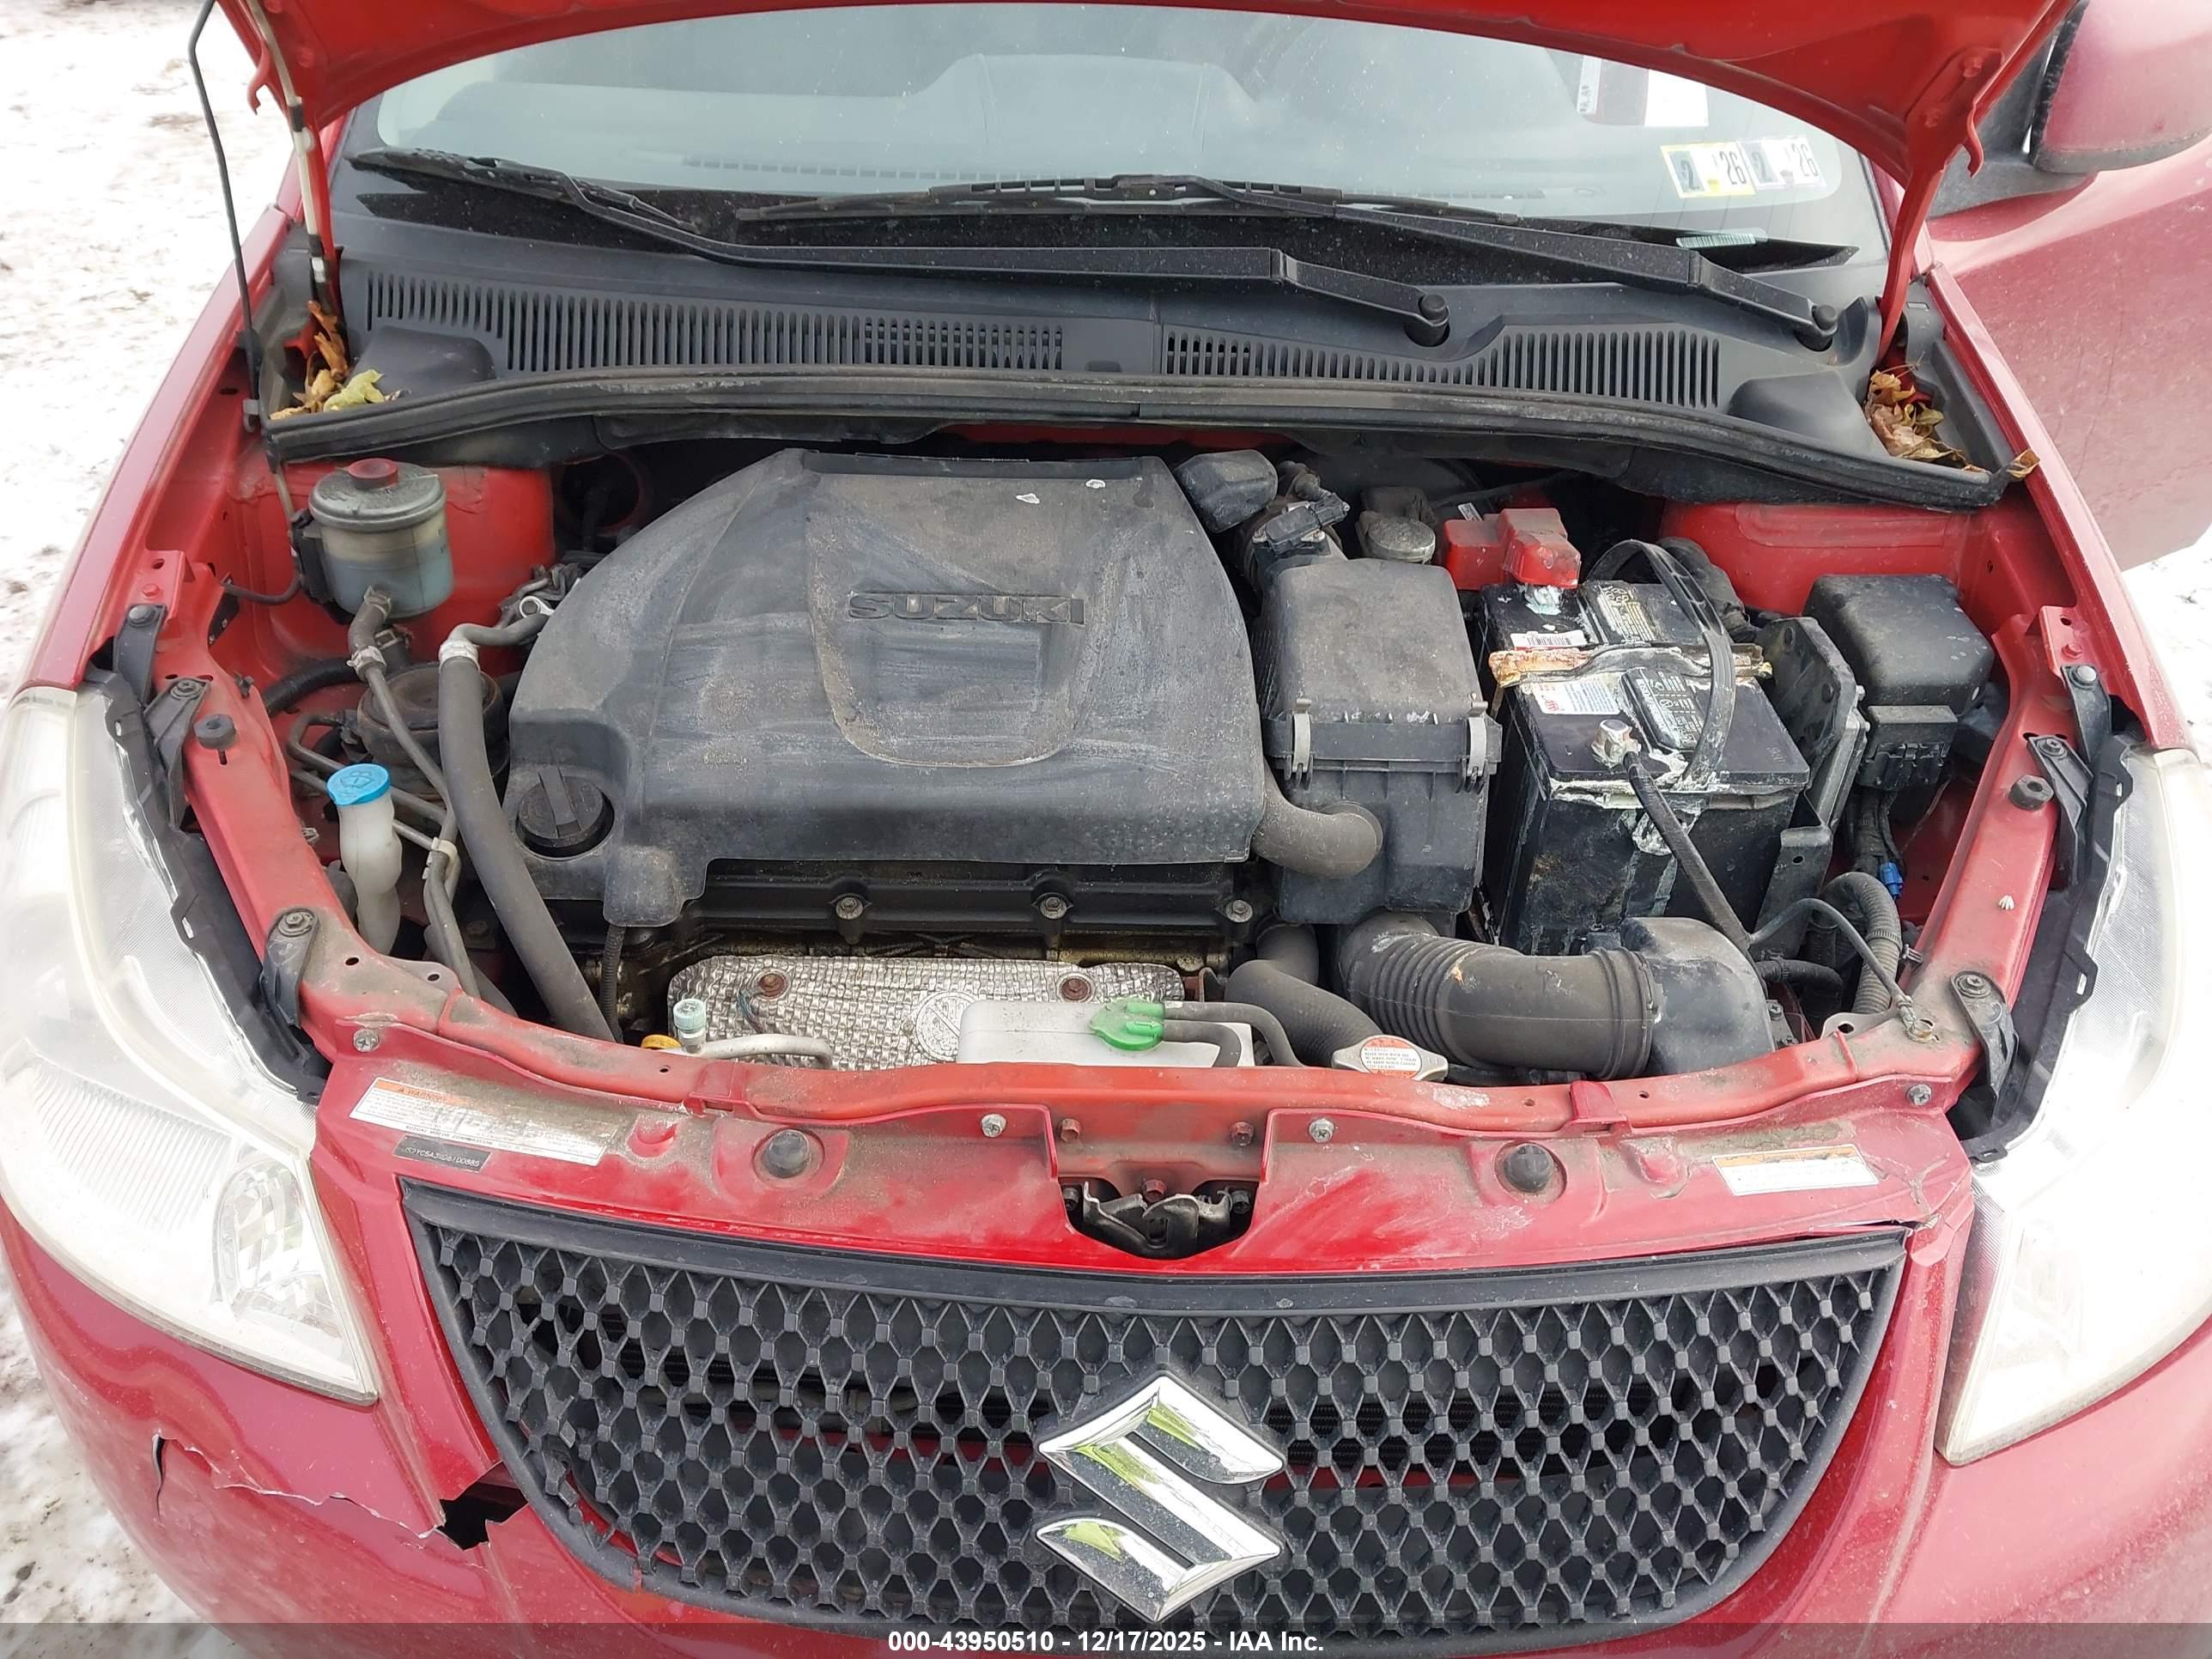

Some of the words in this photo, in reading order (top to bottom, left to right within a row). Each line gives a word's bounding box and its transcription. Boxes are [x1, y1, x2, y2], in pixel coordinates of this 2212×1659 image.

[1680, 160, 1700, 191] 2
[1719, 151, 1747, 185] 26
[1791, 143, 1819, 177] 26
[848, 591, 1085, 625] SUZUKI
